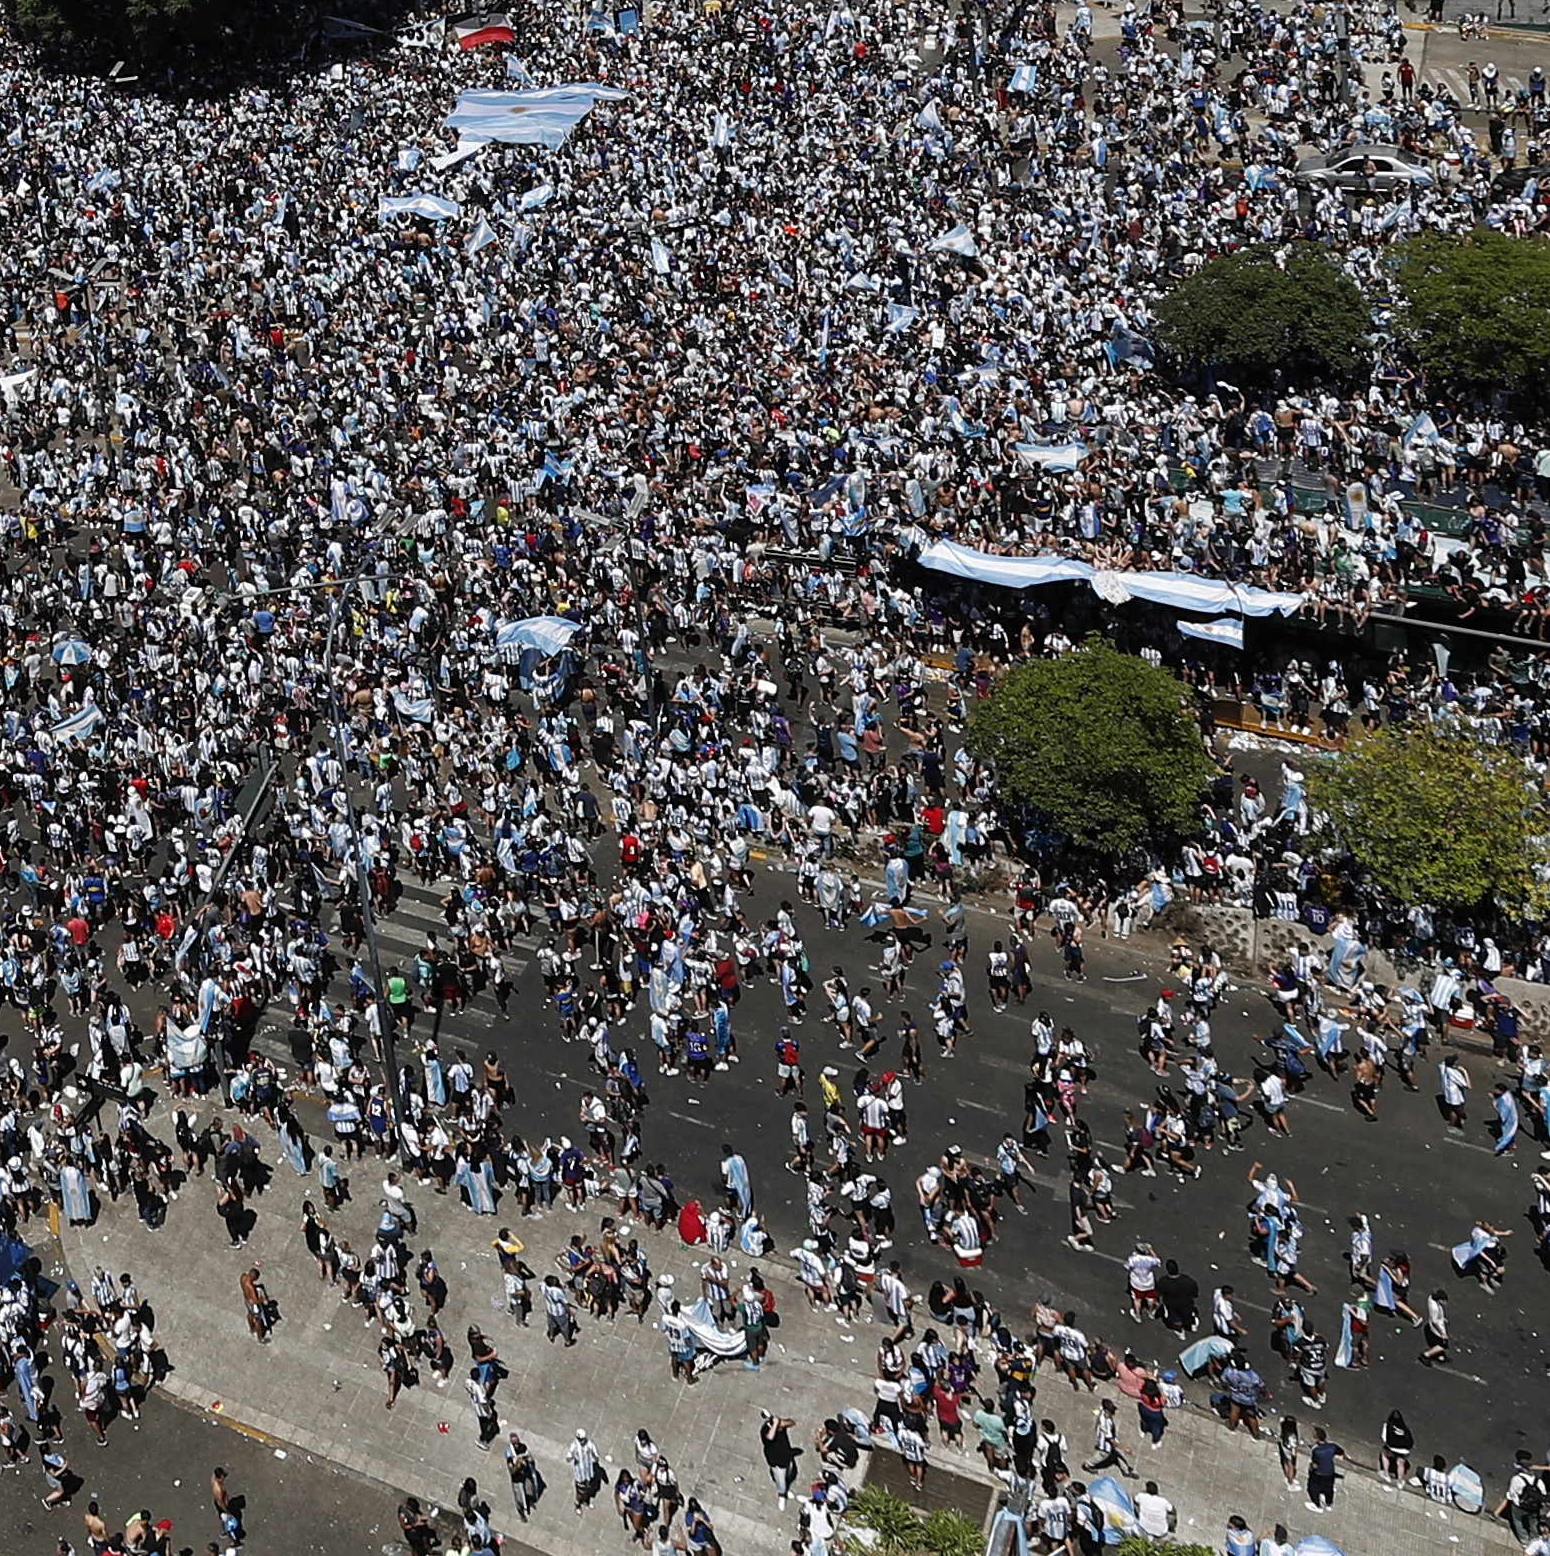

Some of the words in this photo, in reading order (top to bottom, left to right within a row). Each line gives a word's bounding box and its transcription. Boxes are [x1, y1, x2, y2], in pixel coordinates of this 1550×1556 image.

[1281, 899, 1294, 911] 10
[1312, 913, 1325, 924] 10
[371, 1103, 382, 1117] 12
